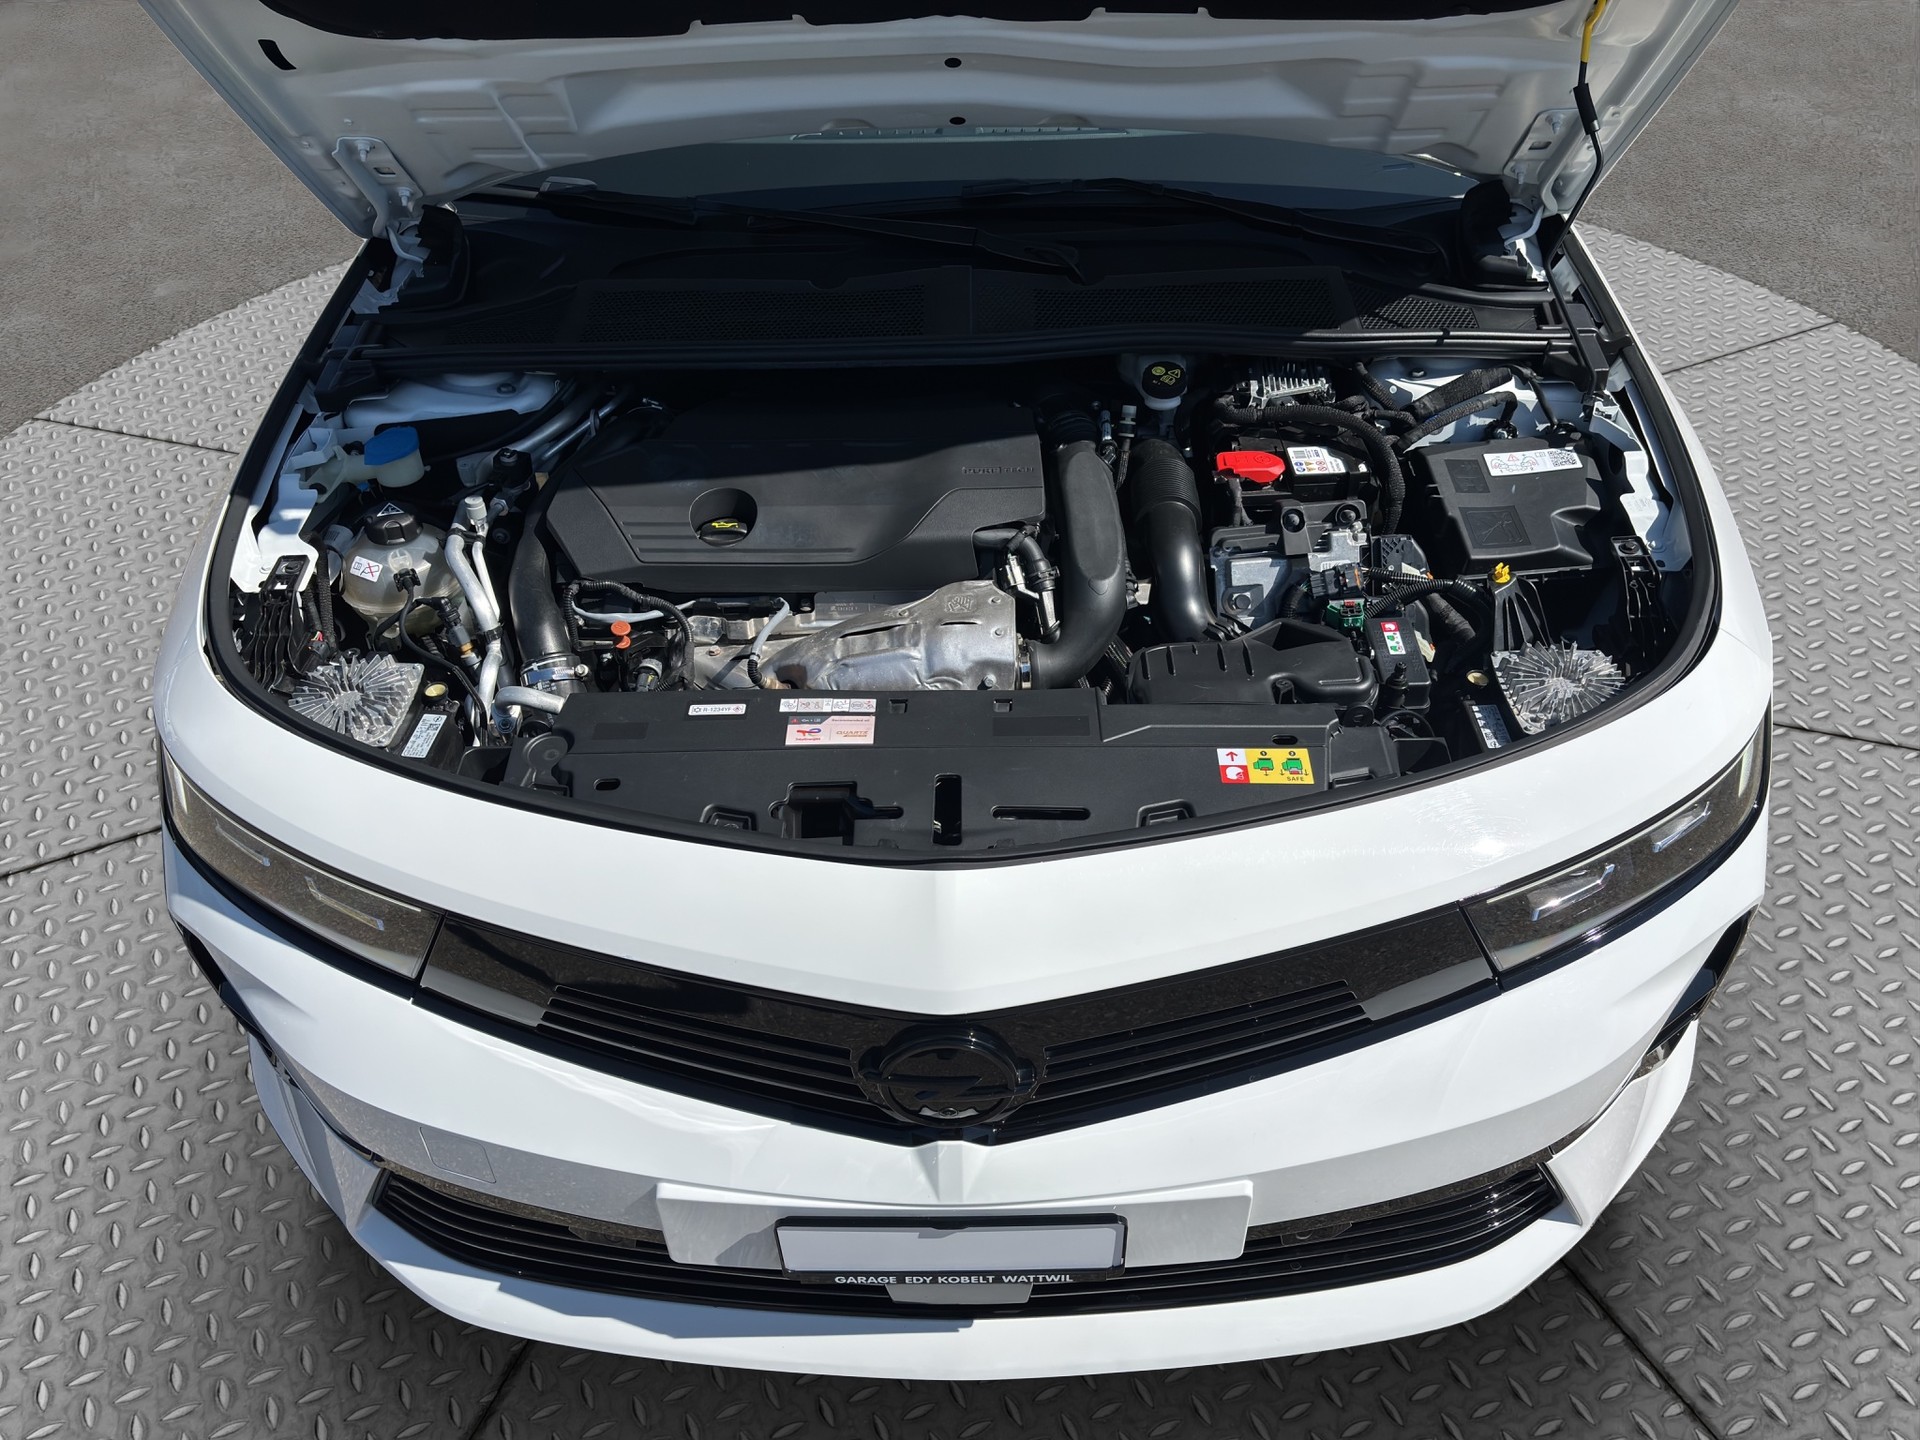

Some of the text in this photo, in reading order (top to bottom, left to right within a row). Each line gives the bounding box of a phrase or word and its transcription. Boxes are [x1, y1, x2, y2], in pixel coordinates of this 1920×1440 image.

[834, 1274, 1074, 1284] GARAGE EDY KOBELT WATTWIL
